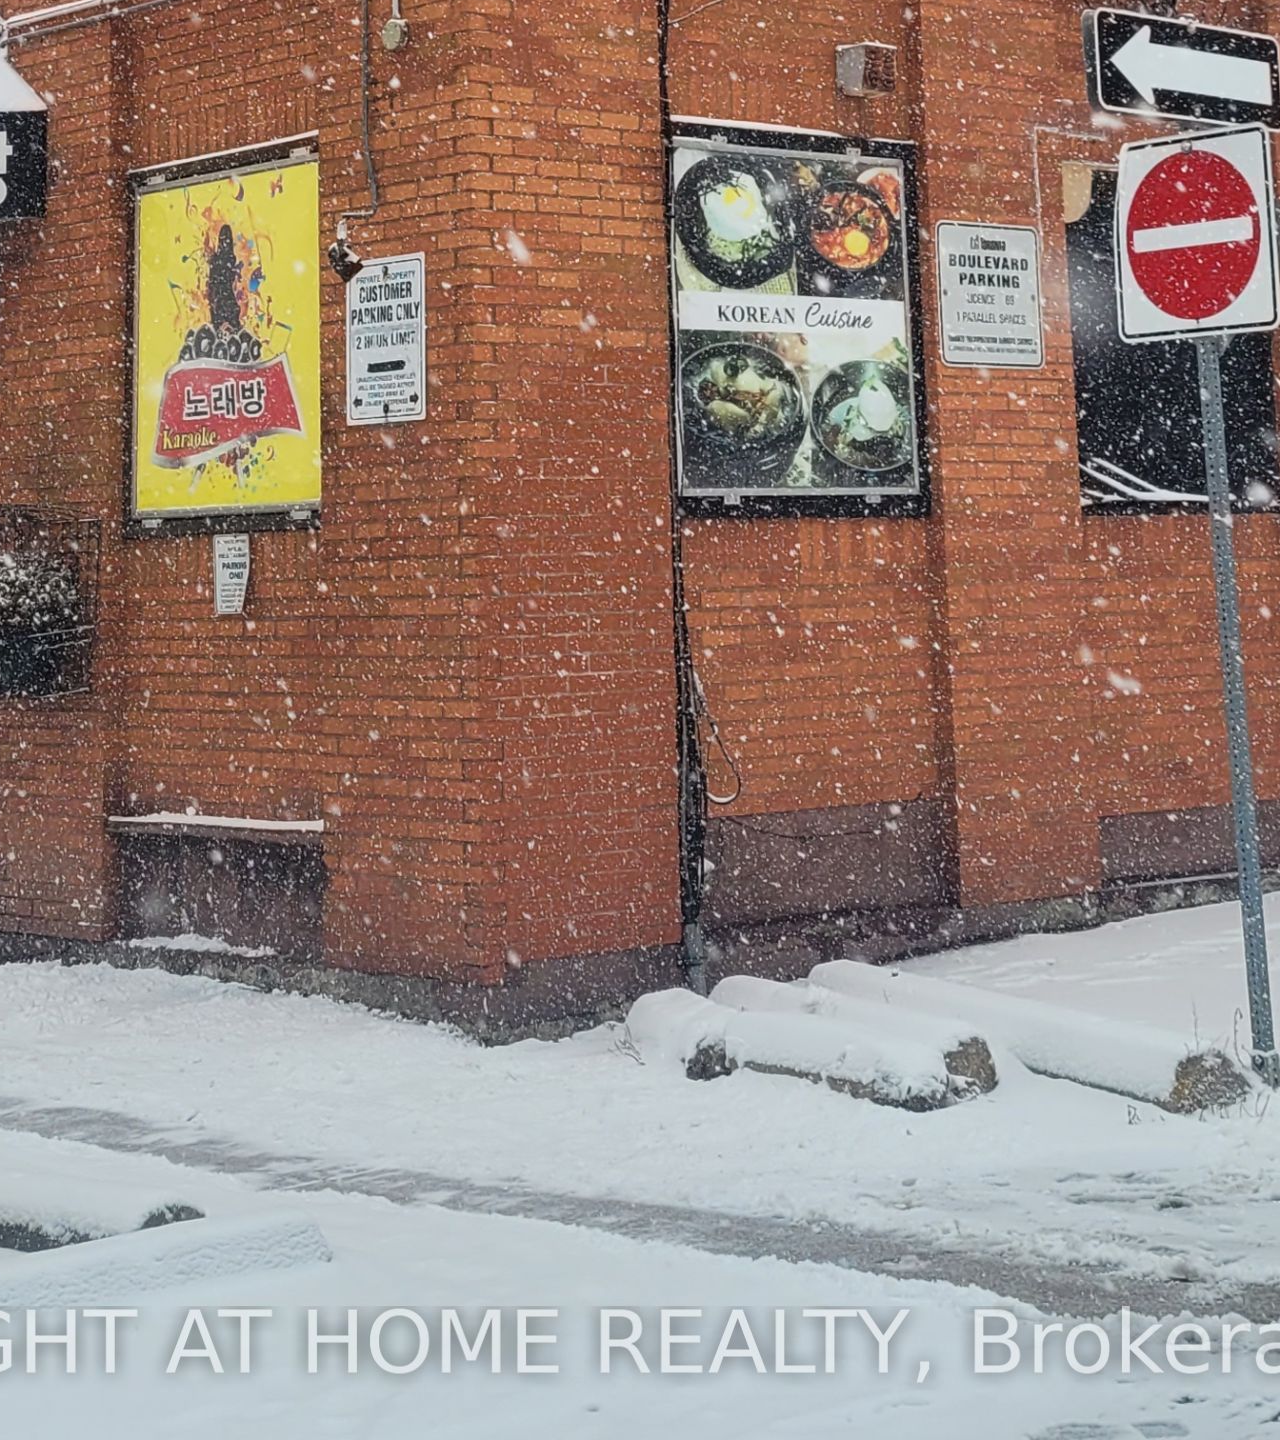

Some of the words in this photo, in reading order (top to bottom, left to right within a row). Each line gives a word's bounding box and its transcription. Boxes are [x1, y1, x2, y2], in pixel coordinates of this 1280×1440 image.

[948, 254, 1028, 271] BOULEVARD
[356, 274, 381, 285] PRIVATE
[959, 272, 1020, 289] PARKING
[359, 281, 413, 304] CUSTOMER
[351, 305, 393, 326] PARKING
[396, 301, 421, 321] ONLY
[718, 304, 796, 324] KOREAN
[804, 302, 873, 329] Cuisine
[356, 335, 362, 350] 2
[182, 378, 267, 421] 노래방
[160, 428, 218, 451] Karaoke
